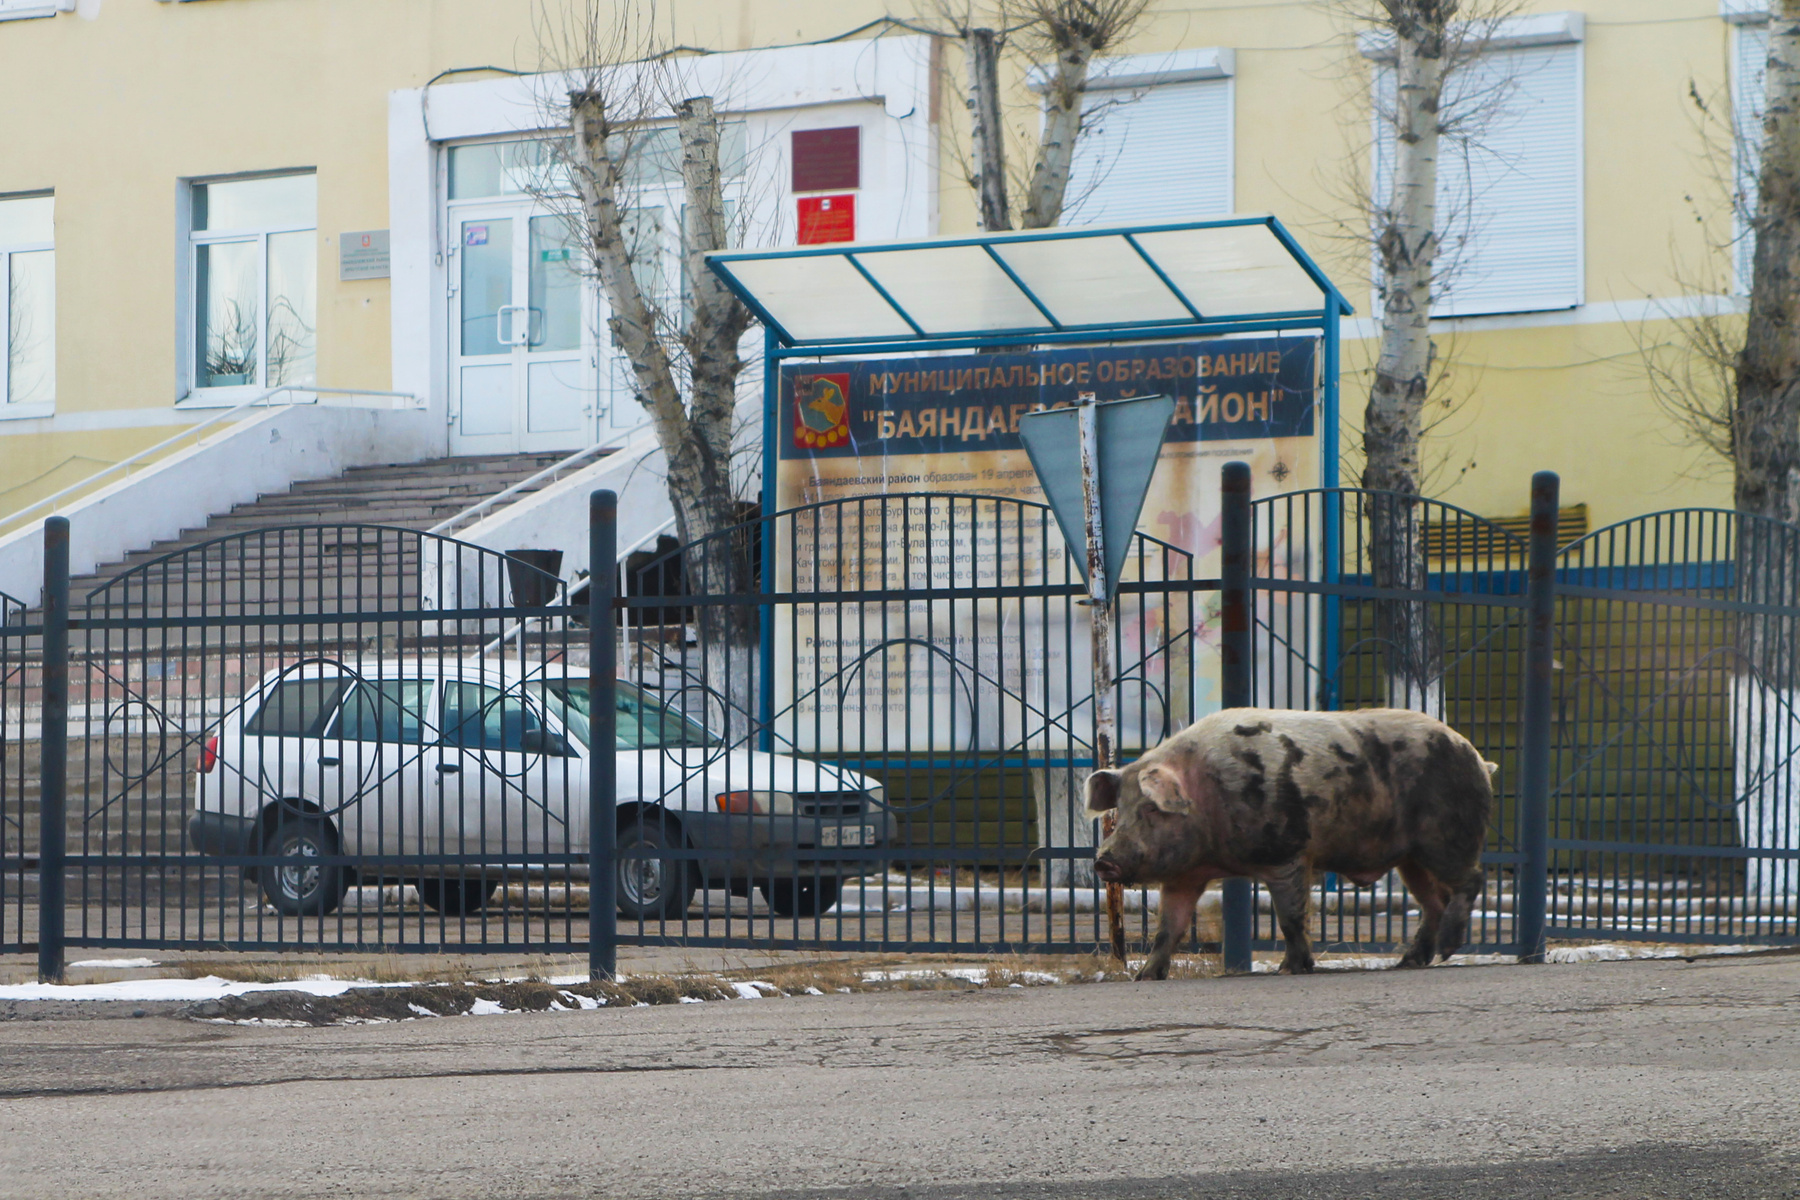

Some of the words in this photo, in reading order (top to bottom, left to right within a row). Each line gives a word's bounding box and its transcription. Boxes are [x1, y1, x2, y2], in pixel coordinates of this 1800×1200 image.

[869, 361, 1092, 396] МУНИЦИПАЛЬНОЕ
[1096, 350, 1281, 383] ОБРАЗОВАНИЕ
[808, 473, 885, 487] Баяндаевский
[887, 473, 920, 486] район
[923, 471, 977, 484] образован
[981, 468, 994, 480] 19
[996, 468, 1034, 481] апреля
